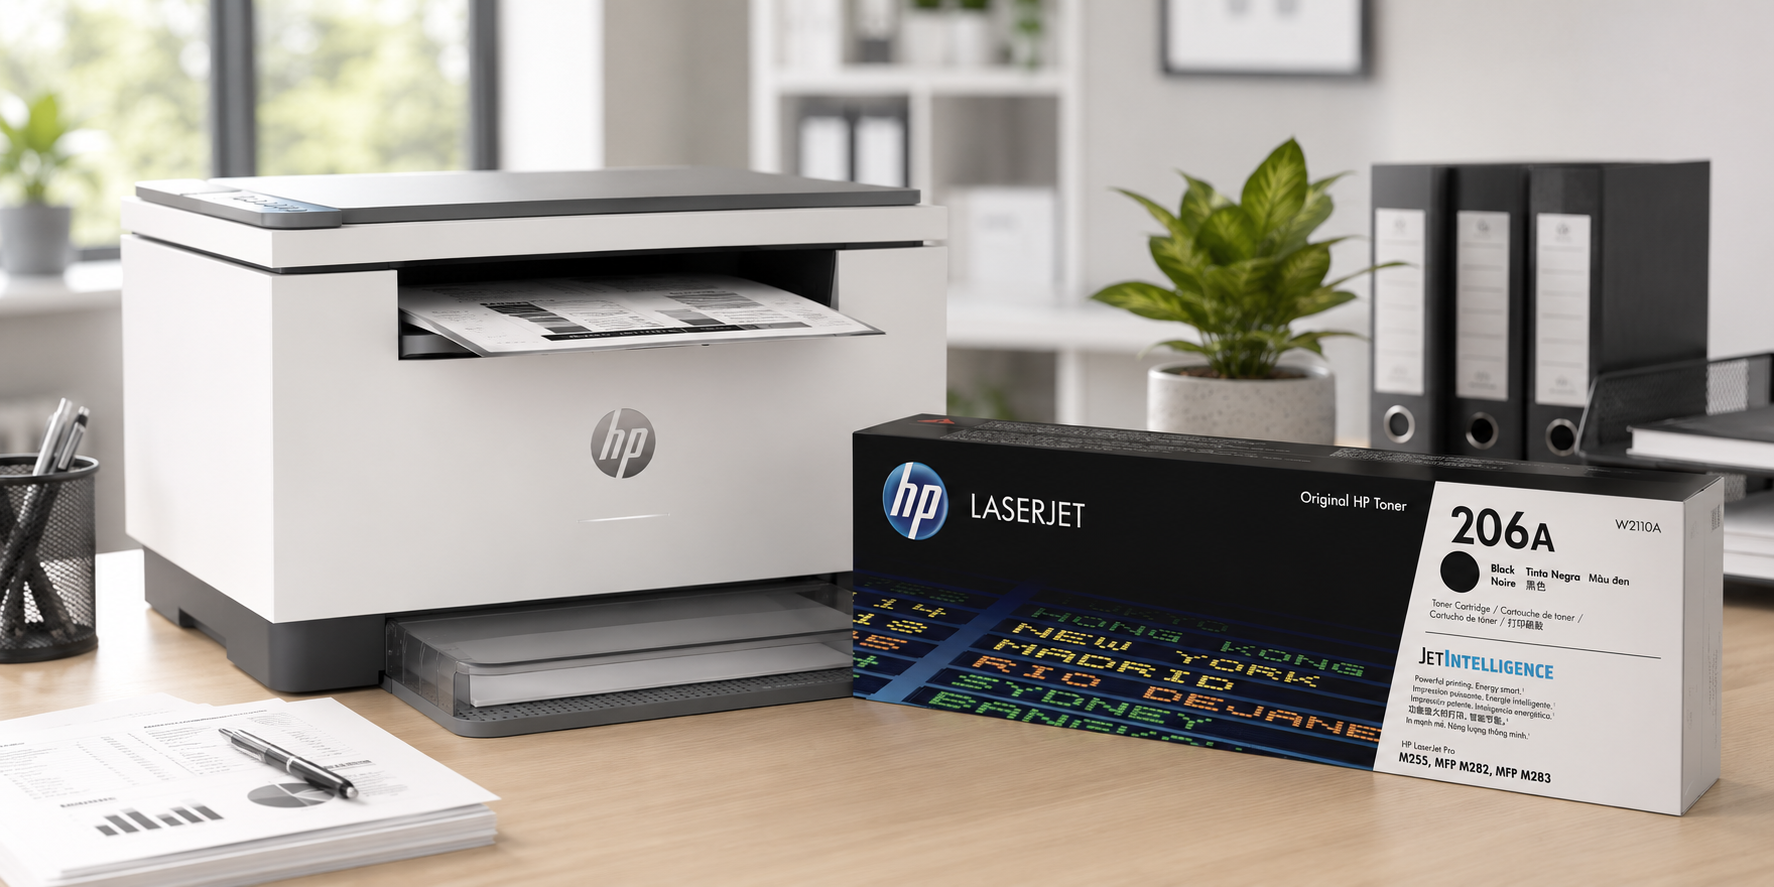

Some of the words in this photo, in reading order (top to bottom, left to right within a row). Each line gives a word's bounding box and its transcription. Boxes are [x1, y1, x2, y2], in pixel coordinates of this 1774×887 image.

[598, 408, 649, 479] hp
[890, 462, 943, 540] hp
[971, 493, 1086, 528] LASERJET
[1300, 491, 1349, 509] Original
[1353, 495, 1370, 509] HP
[1374, 497, 1407, 512] Toner
[1451, 505, 1555, 552] 206A
[1615, 519, 1662, 534] W2110A
[1491, 563, 1515, 575] Black
[1551, 570, 1581, 583] Negra
[1589, 573, 1610, 585] Màu
[1491, 576, 1516, 588] Noire
[1429, 610, 1464, 622] Cartucho
[1466, 614, 1476, 623] de
[1478, 615, 1497, 625] tóner
[1500, 617, 1505, 627] /
[1432, 599, 1452, 609] Toner
[1455, 601, 1491, 614] Cartridge
[1493, 605, 1498, 615] /
[1500, 606, 1540, 619] Cartouche
[1542, 610, 1553, 620] de
[1554, 613, 1575, 622] toner
[1577, 614, 1584, 623] /
[1012, 622, 1132, 651] NEW
[1176, 650, 1320, 688] YORK
[1031, 607, 1184, 643] HONG
[1220, 641, 1364, 677] KONG
[972, 655, 1101, 688] RIO
[993, 638, 1234, 690] MADRID
[951, 674, 1212, 730] SYDNEY
[1475, 682, 1499, 694] Energy
[1401, 740, 1412, 749] HP
[1413, 742, 1442, 753] LaserJet
[1443, 745, 1456, 755] Pro
[1398, 752, 1431, 768] M255,
[1434, 757, 1457, 770] MFP
[1459, 760, 1493, 776] M282,
[1495, 765, 1518, 779] MFP
[1520, 769, 1551, 784] M283
